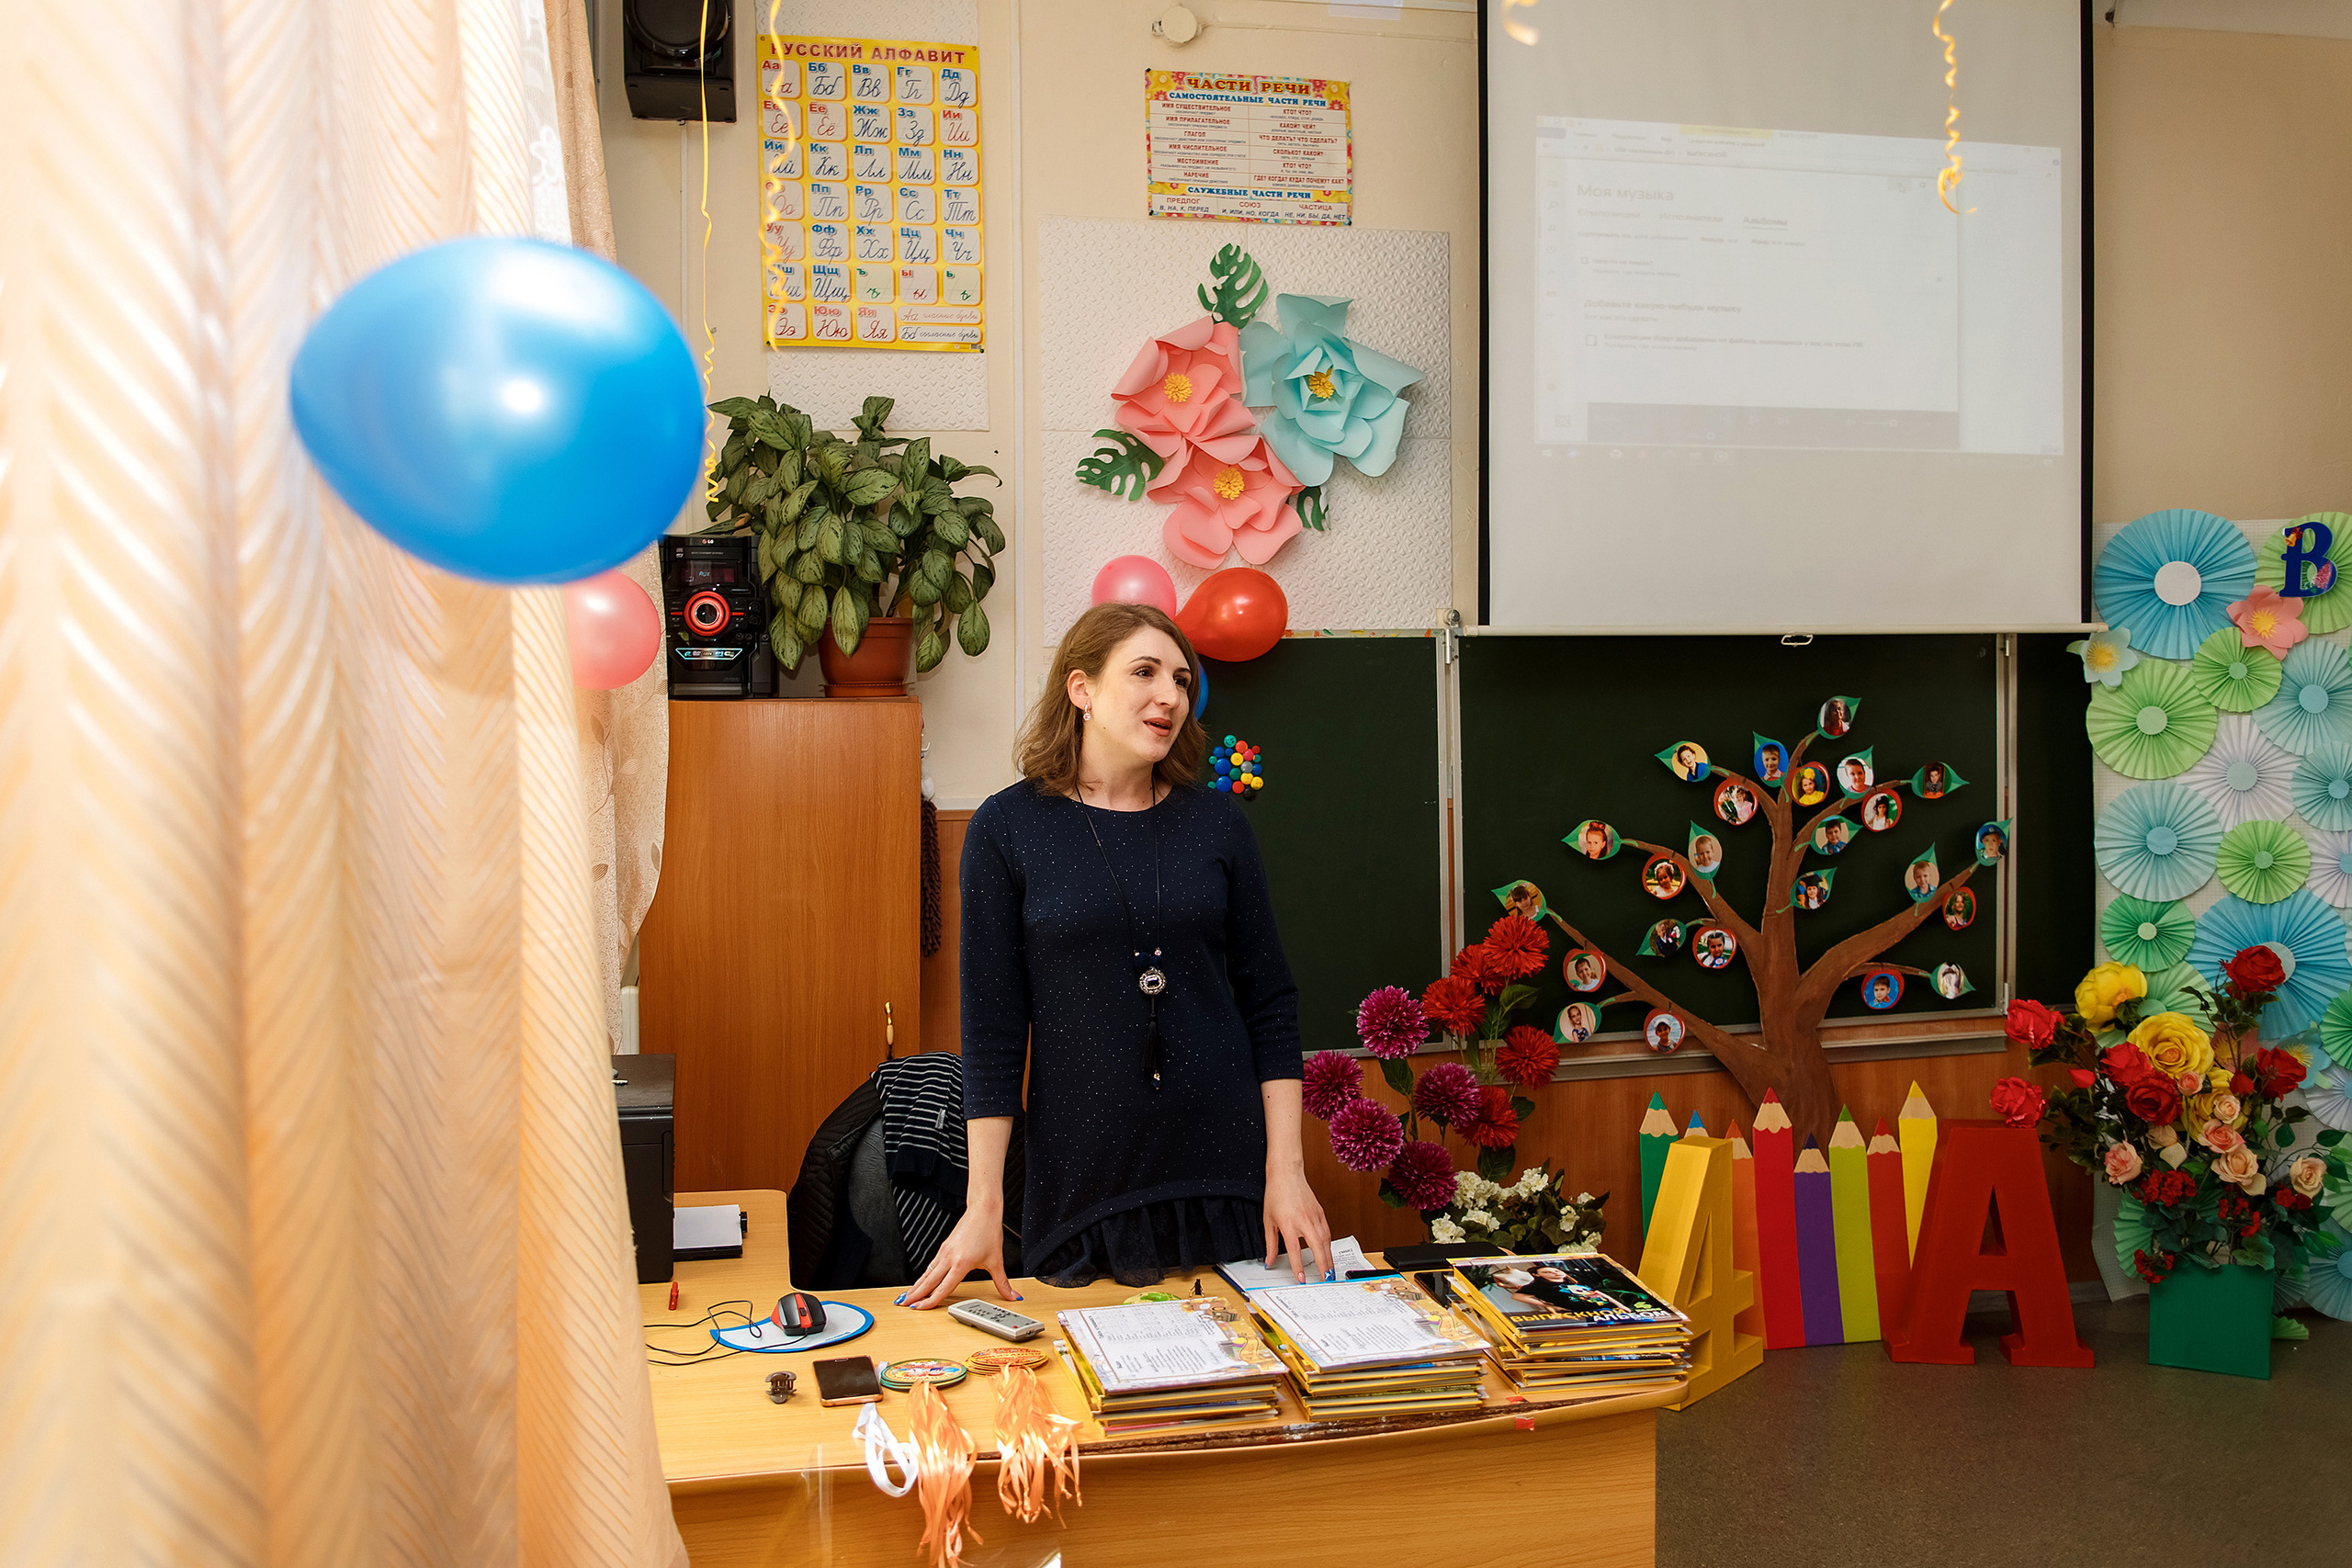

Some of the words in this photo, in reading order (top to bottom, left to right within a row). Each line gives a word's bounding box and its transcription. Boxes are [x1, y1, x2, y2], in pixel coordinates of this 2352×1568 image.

[871, 47, 965, 63] АЛФАВИТ
[762, 60, 780, 70] Аа
[808, 62, 826, 73] Бб
[853, 64, 869, 73] Вв
[897, 67, 910, 76] Гг
[941, 69, 959, 79] Дд
[813, 76, 842, 96] Бб
[857, 77, 881, 97] Вв
[944, 82, 969, 108] Дд
[1186, 77, 1251, 92] ЧАСТИ
[1261, 81, 1310, 96] РЕЧИ
[1169, 92, 1263, 104] САМОСТОЯТЕЛЬНЫЕ
[1268, 96, 1298, 106] ЧАСТИ
[763, 100, 781, 111] Ее
[853, 105, 877, 115] Жж
[898, 107, 913, 117] Зз
[942, 110, 960, 119] Ии
[1175, 104, 1231, 112] СУЩЕСТВИТЕЛЬНОЕ
[1179, 117, 1230, 125] ПРИЛАГАТЕЛЬНОЕ
[771, 113, 789, 134] Ее
[817, 113, 835, 136] Ёё
[854, 118, 888, 139] Жж
[906, 120, 924, 147] Зз
[947, 122, 970, 142] Ии
[764, 139, 783, 151] Йй
[809, 142, 827, 152] Кк
[854, 145, 872, 154] Лл
[899, 148, 920, 157] Мм
[944, 150, 961, 159] Нн
[815, 156, 839, 176] Кк
[857, 159, 885, 177] Лл
[899, 161, 933, 180] Мм
[946, 162, 973, 181] Нн
[811, 184, 829, 193] Пп
[855, 186, 872, 197] Рр
[899, 187, 916, 197] Сс
[944, 189, 958, 198] Тт
[1187, 186, 1249, 197] СЛУЖЕБНЫЕ
[1577, 184, 1611, 198] Моя
[1616, 186, 1674, 202] музыка
[813, 197, 844, 218] Пп
[860, 197, 883, 225] Рр
[905, 199, 924, 220] Сс
[943, 201, 975, 221] Тт
[766, 223, 782, 234] Уу
[811, 224, 835, 235] Фф
[855, 226, 873, 235] Хх
[900, 228, 918, 238] Цц
[945, 229, 962, 238] Чч
[815, 238, 843, 265] Фф
[859, 239, 888, 259] Хх
[903, 241, 930, 265] Цц
[952, 242, 972, 261] Чч
[773, 265, 793, 274] ш
[813, 265, 839, 276] Щщ
[813, 277, 850, 303] Щщ
[814, 306, 840, 316] Юю
[858, 308, 876, 317] Яя
[900, 308, 919, 321] Аа
[775, 317, 796, 337] Ээ
[816, 319, 847, 340] Юю
[863, 321, 888, 340] Яя
[900, 326, 922, 340] Бб
[1592, 1309, 1670, 1322] АЛЬБОМ
